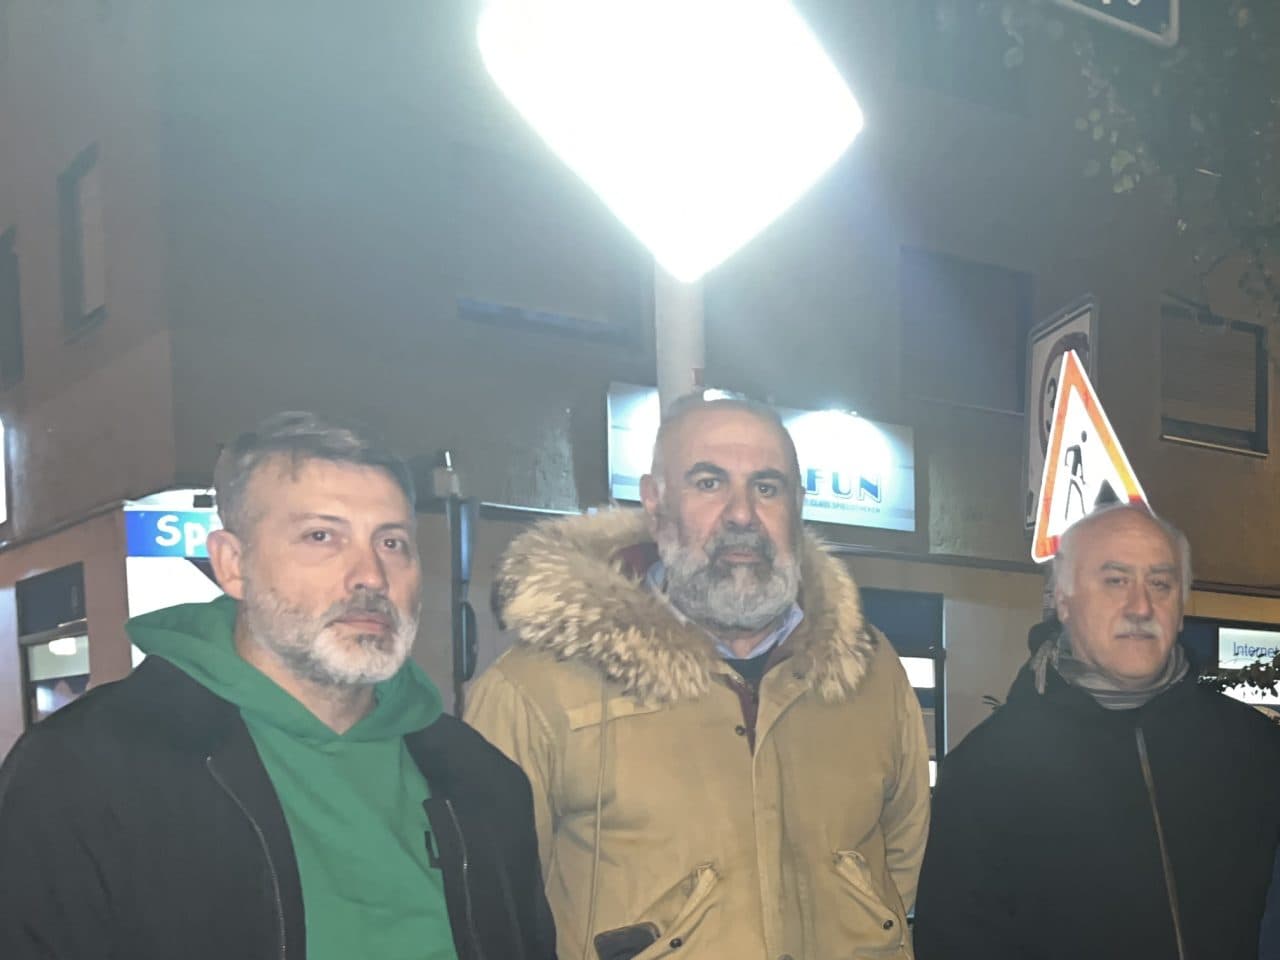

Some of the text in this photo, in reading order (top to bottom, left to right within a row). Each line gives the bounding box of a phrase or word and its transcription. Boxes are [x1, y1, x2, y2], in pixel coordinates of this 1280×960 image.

[806, 467, 881, 503] FUN
[155, 514, 210, 557] Sp
[1233, 641, 1280, 658] Internet
